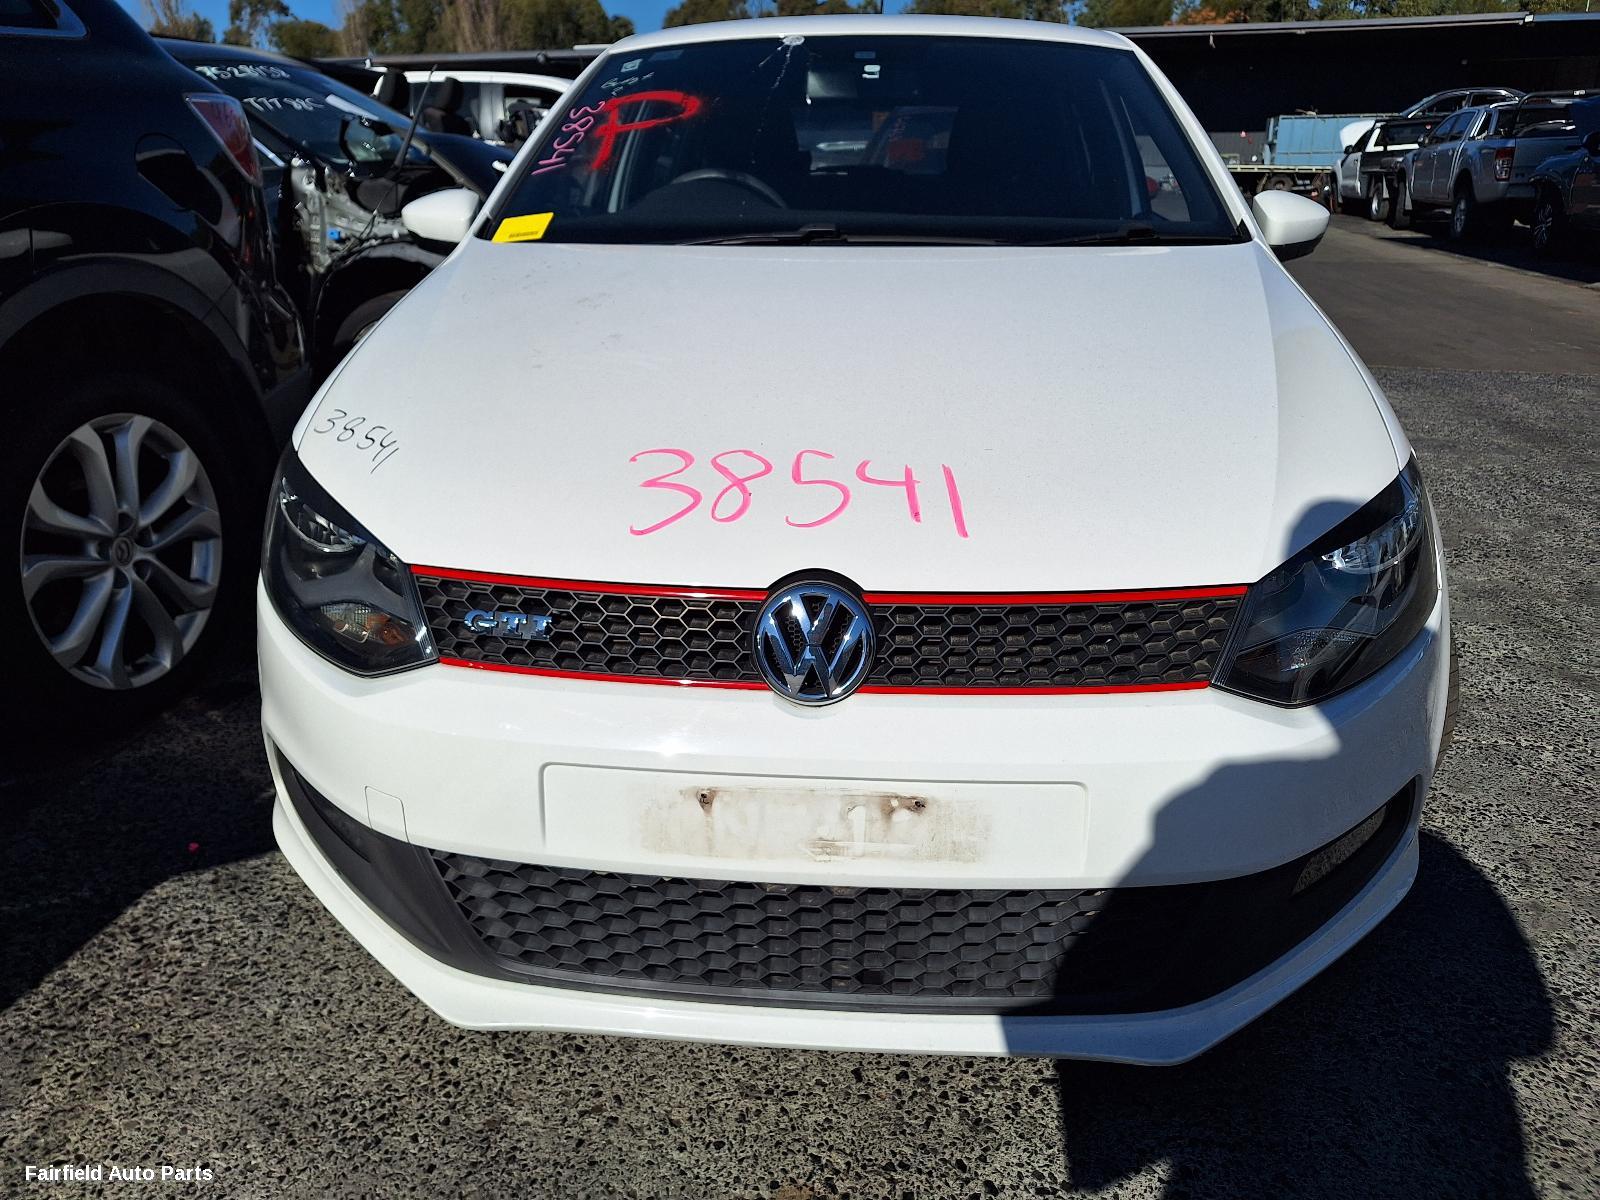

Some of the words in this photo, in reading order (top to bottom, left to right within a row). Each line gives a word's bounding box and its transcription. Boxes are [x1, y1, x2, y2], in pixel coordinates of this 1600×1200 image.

[530, 100, 606, 176] 38541
[313, 408, 400, 474] 38541
[629, 448, 969, 539] 38541
[464, 609, 552, 640] GTI
